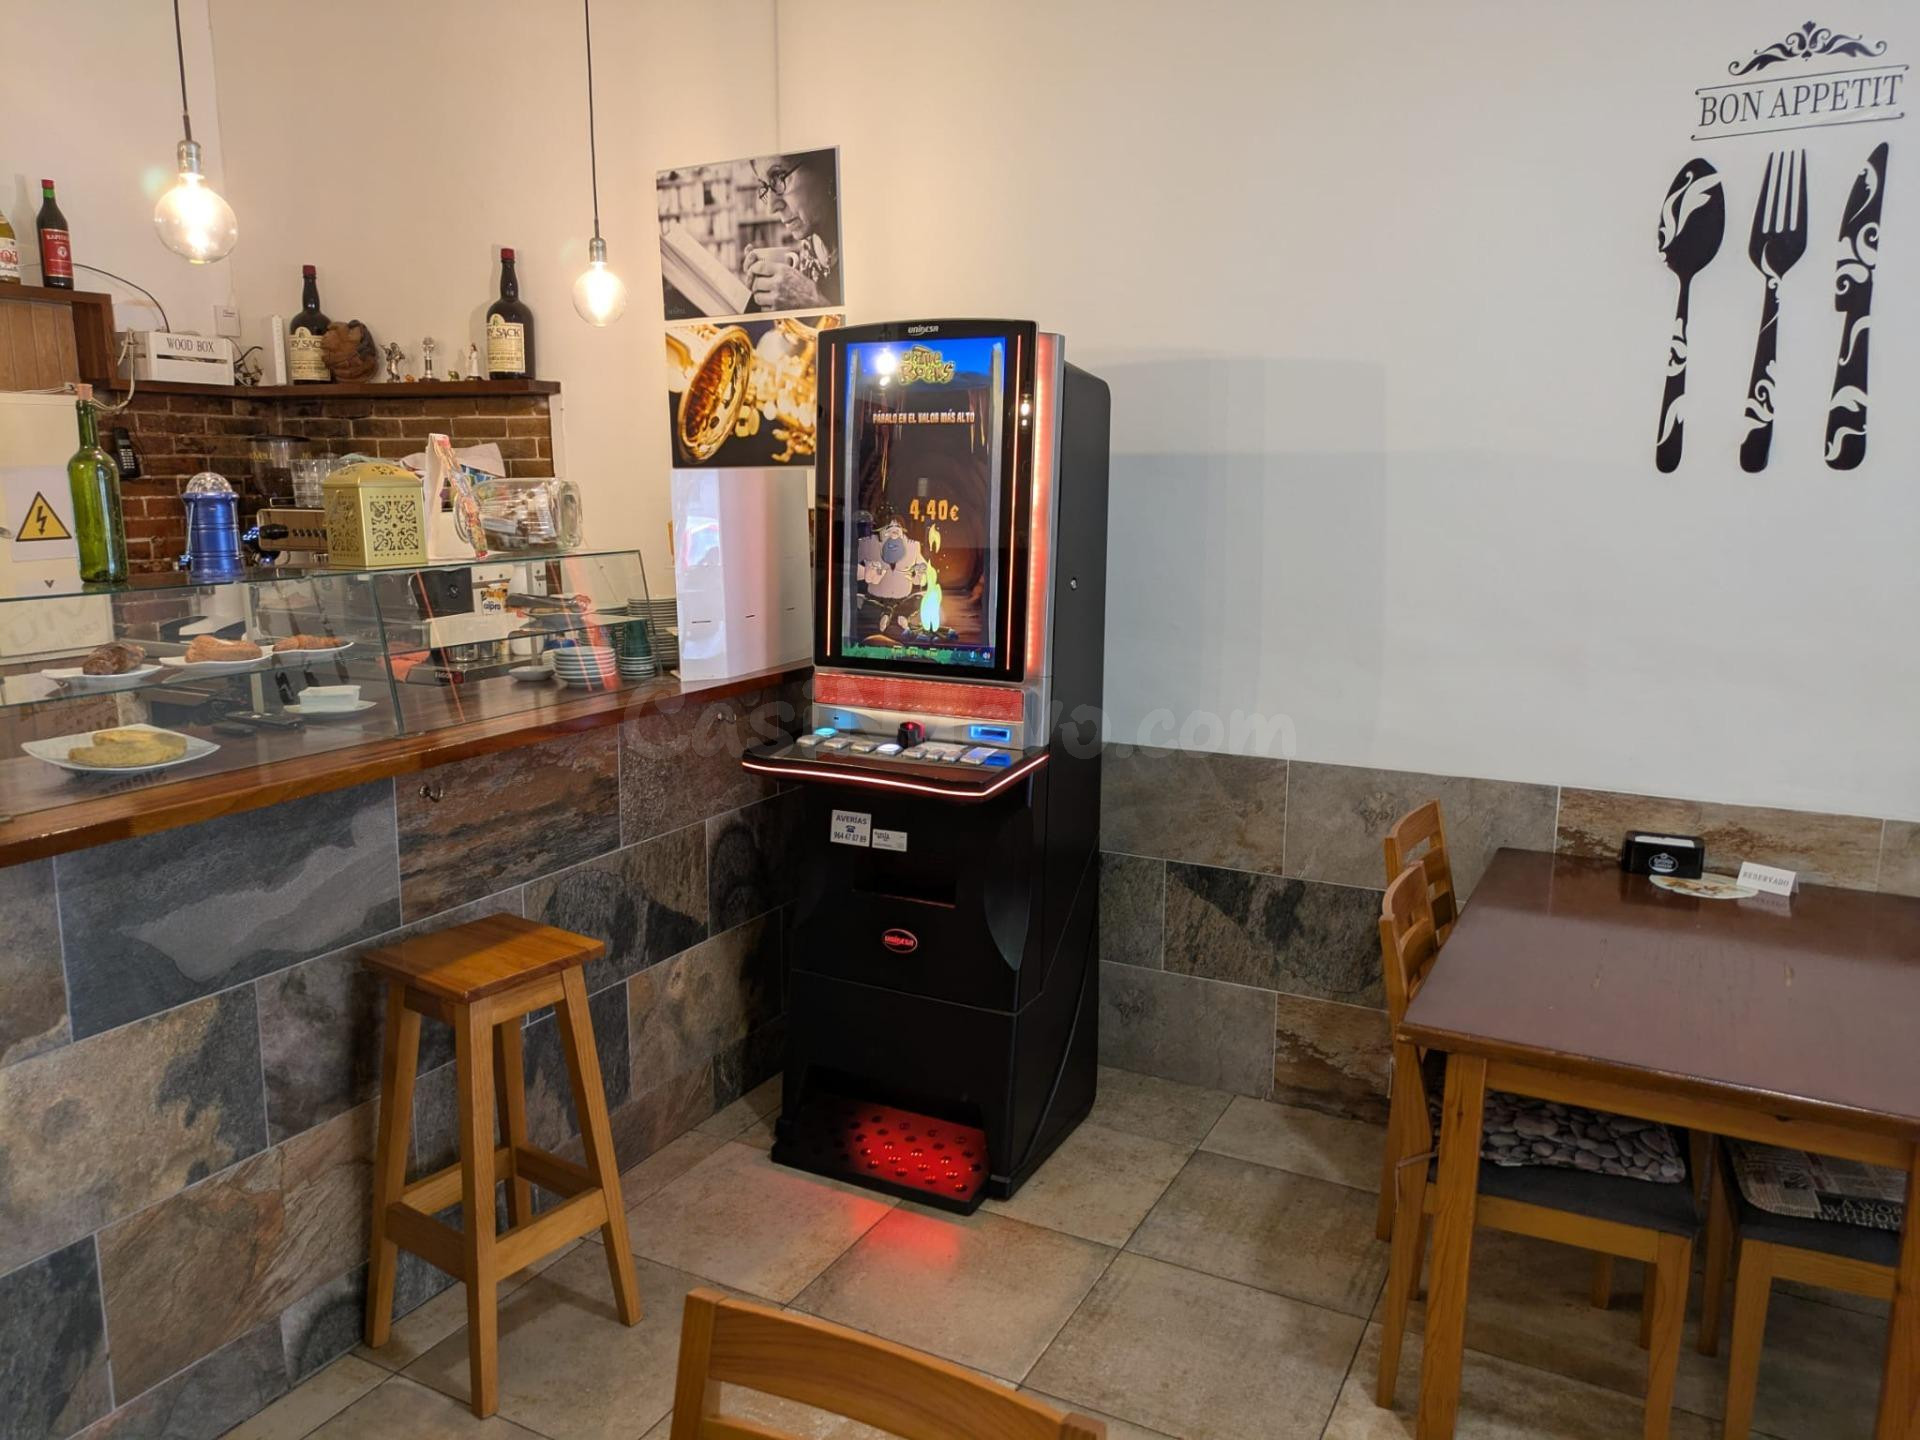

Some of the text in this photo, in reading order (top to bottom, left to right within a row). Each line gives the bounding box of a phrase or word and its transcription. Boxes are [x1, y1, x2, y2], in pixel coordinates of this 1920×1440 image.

[1698, 74, 1904, 127] BON APPETIT
[496, 327, 520, 339] SACK
[166, 337, 214, 353] WOOD BOX
[303, 340, 321, 349] SAC
[957, 411, 975, 424] ALTO
[836, 814, 867, 825] AVERÍAS
